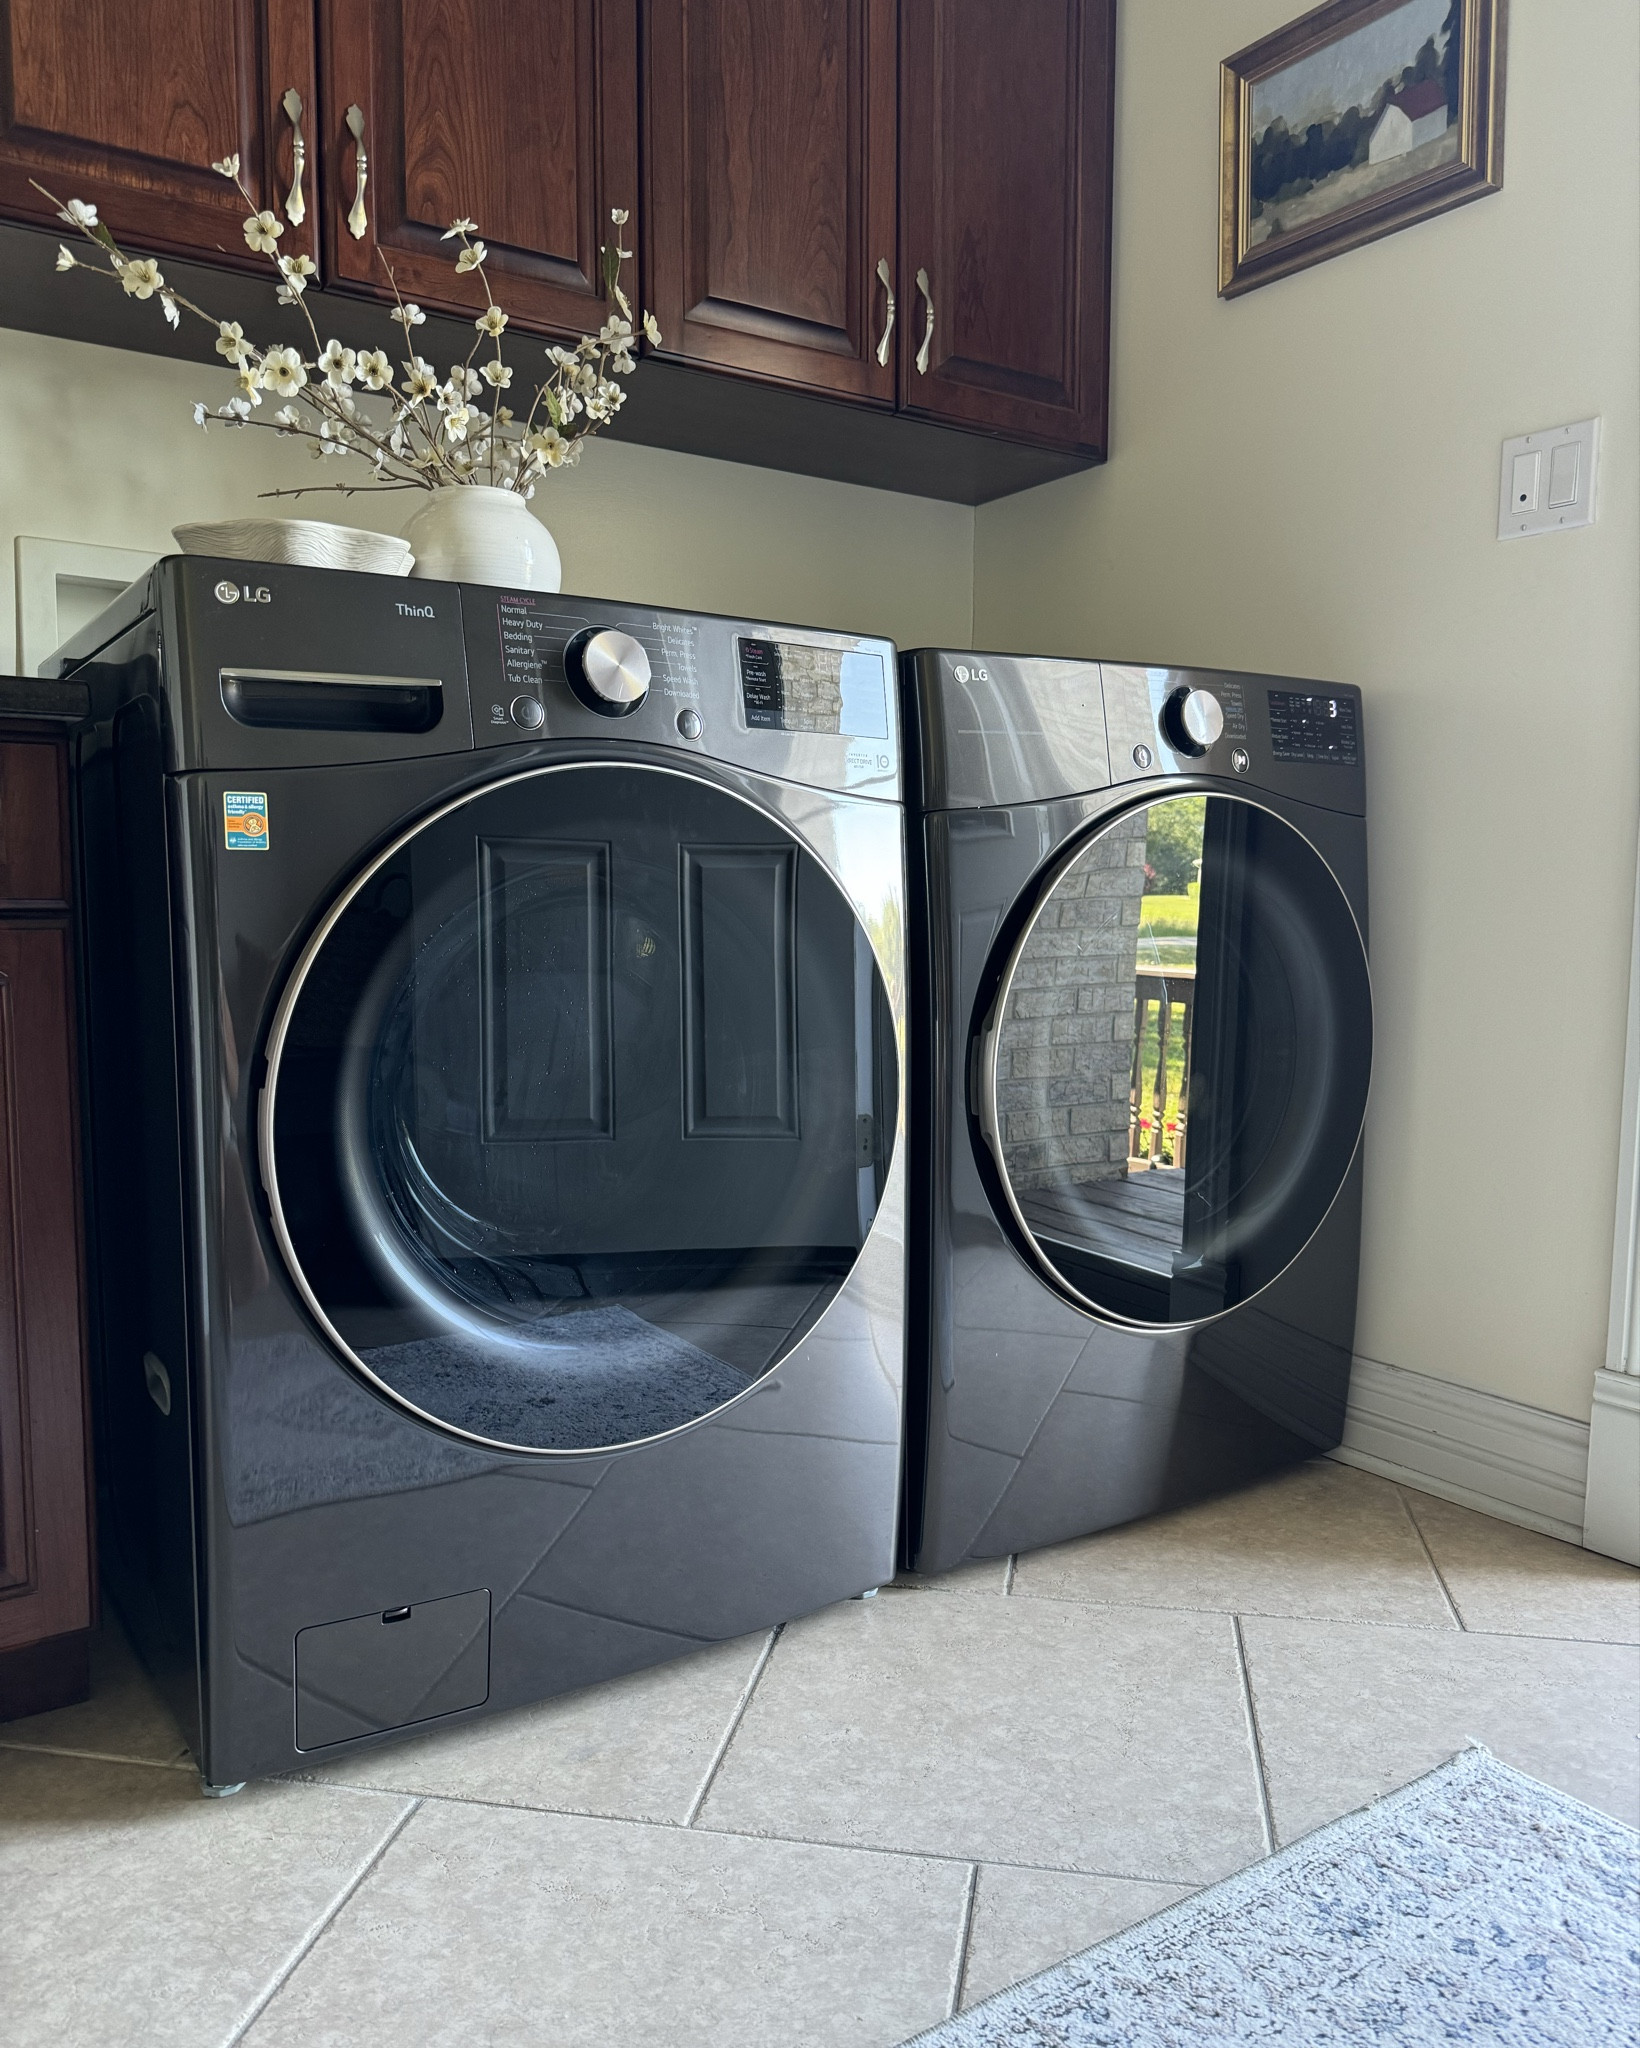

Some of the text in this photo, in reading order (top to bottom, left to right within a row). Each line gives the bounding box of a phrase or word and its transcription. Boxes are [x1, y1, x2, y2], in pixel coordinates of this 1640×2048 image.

[243, 585, 271, 603] LG
[395, 603, 435, 618] ThinQ
[501, 605, 527, 615] Normal
[502, 618, 543, 630] Heavy Duty
[653, 622, 671, 633] Bright
[503, 631, 533, 643] Bedding
[667, 636, 695, 647] Delicates
[505, 645, 535, 657] Sanitary
[680, 651, 696, 660] Press
[678, 663, 697, 672] Towels
[508, 674, 543, 684] Tub Clean
[662, 674, 681, 684] Speed
[971, 668, 988, 681] LG
[664, 688, 700, 699] Downloaded
[1329, 700, 1337, 717] 3
[227, 796, 264, 804] CERTIFIED
